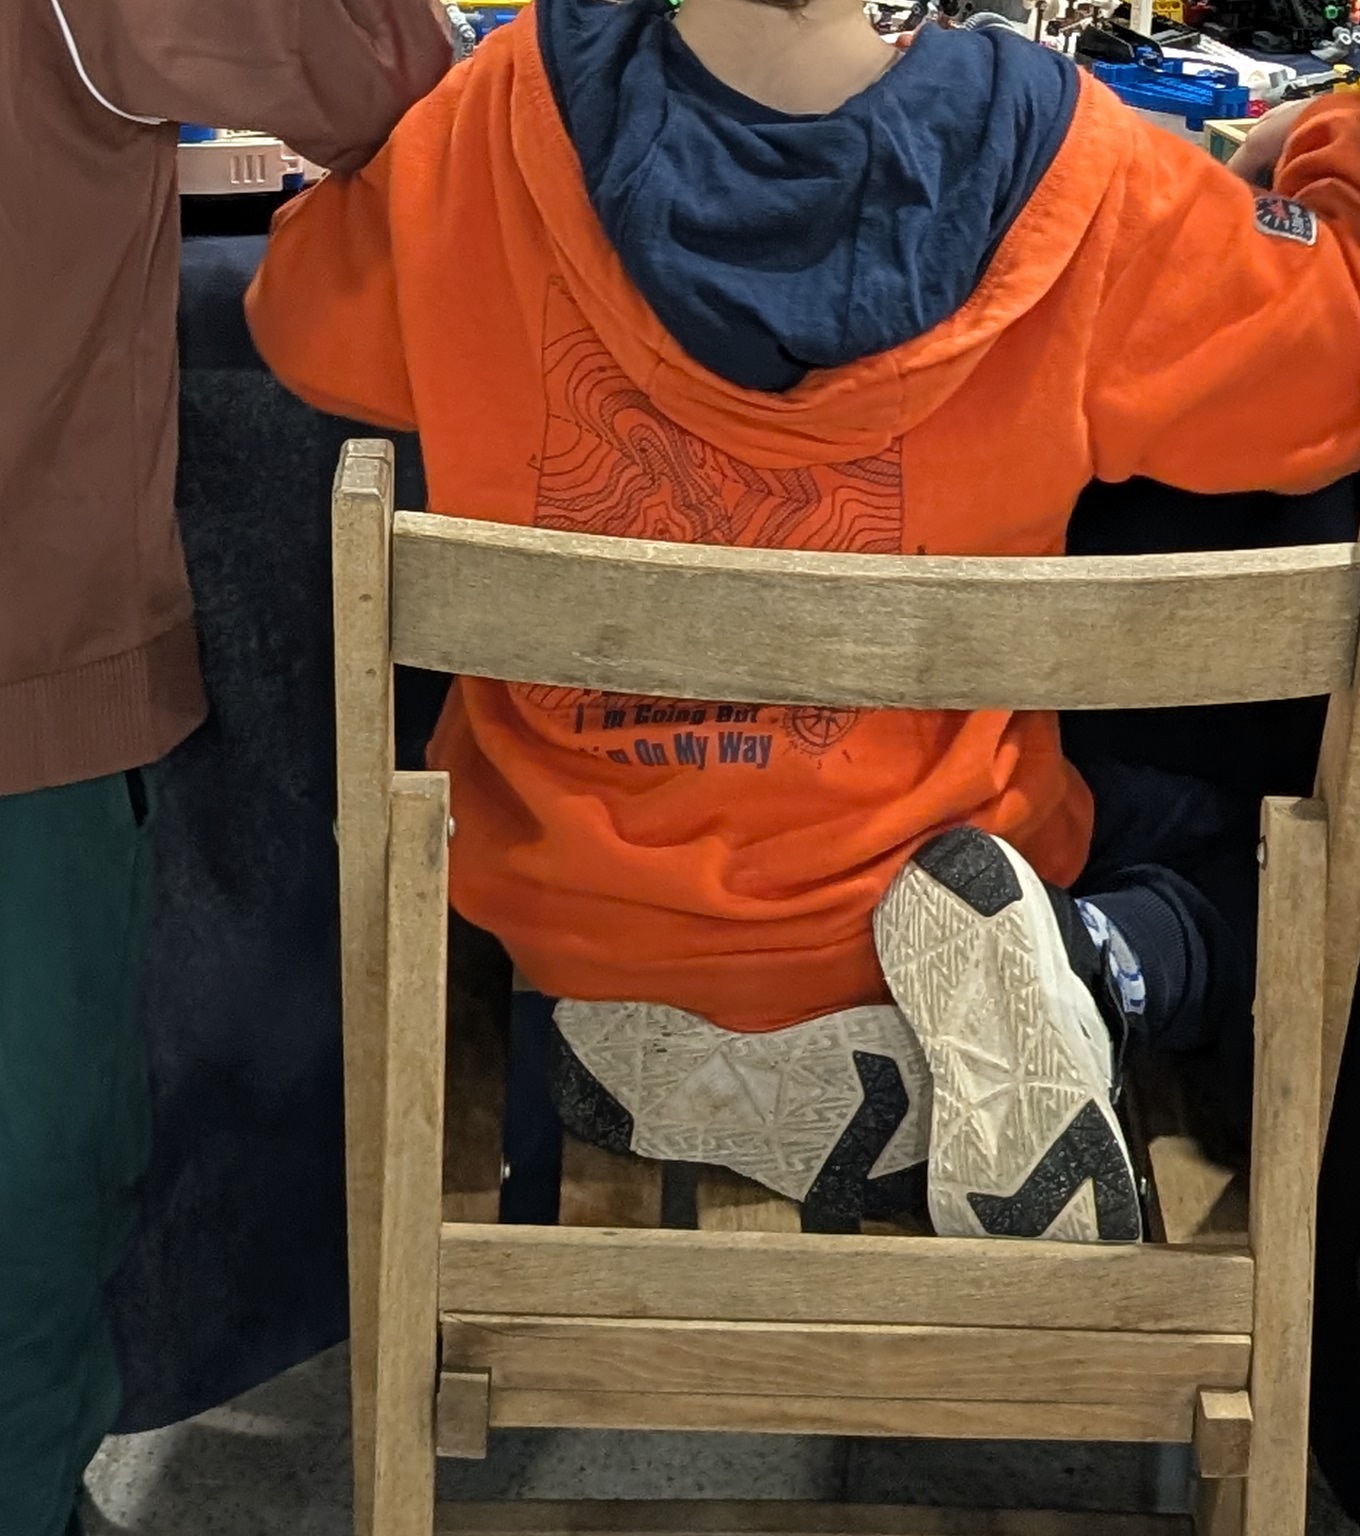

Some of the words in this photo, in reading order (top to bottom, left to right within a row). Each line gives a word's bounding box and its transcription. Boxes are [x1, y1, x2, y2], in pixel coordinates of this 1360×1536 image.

[635, 704, 707, 725] Going
[634, 739, 670, 766] On
[674, 731, 709, 770] My
[718, 731, 773, 770] Way
